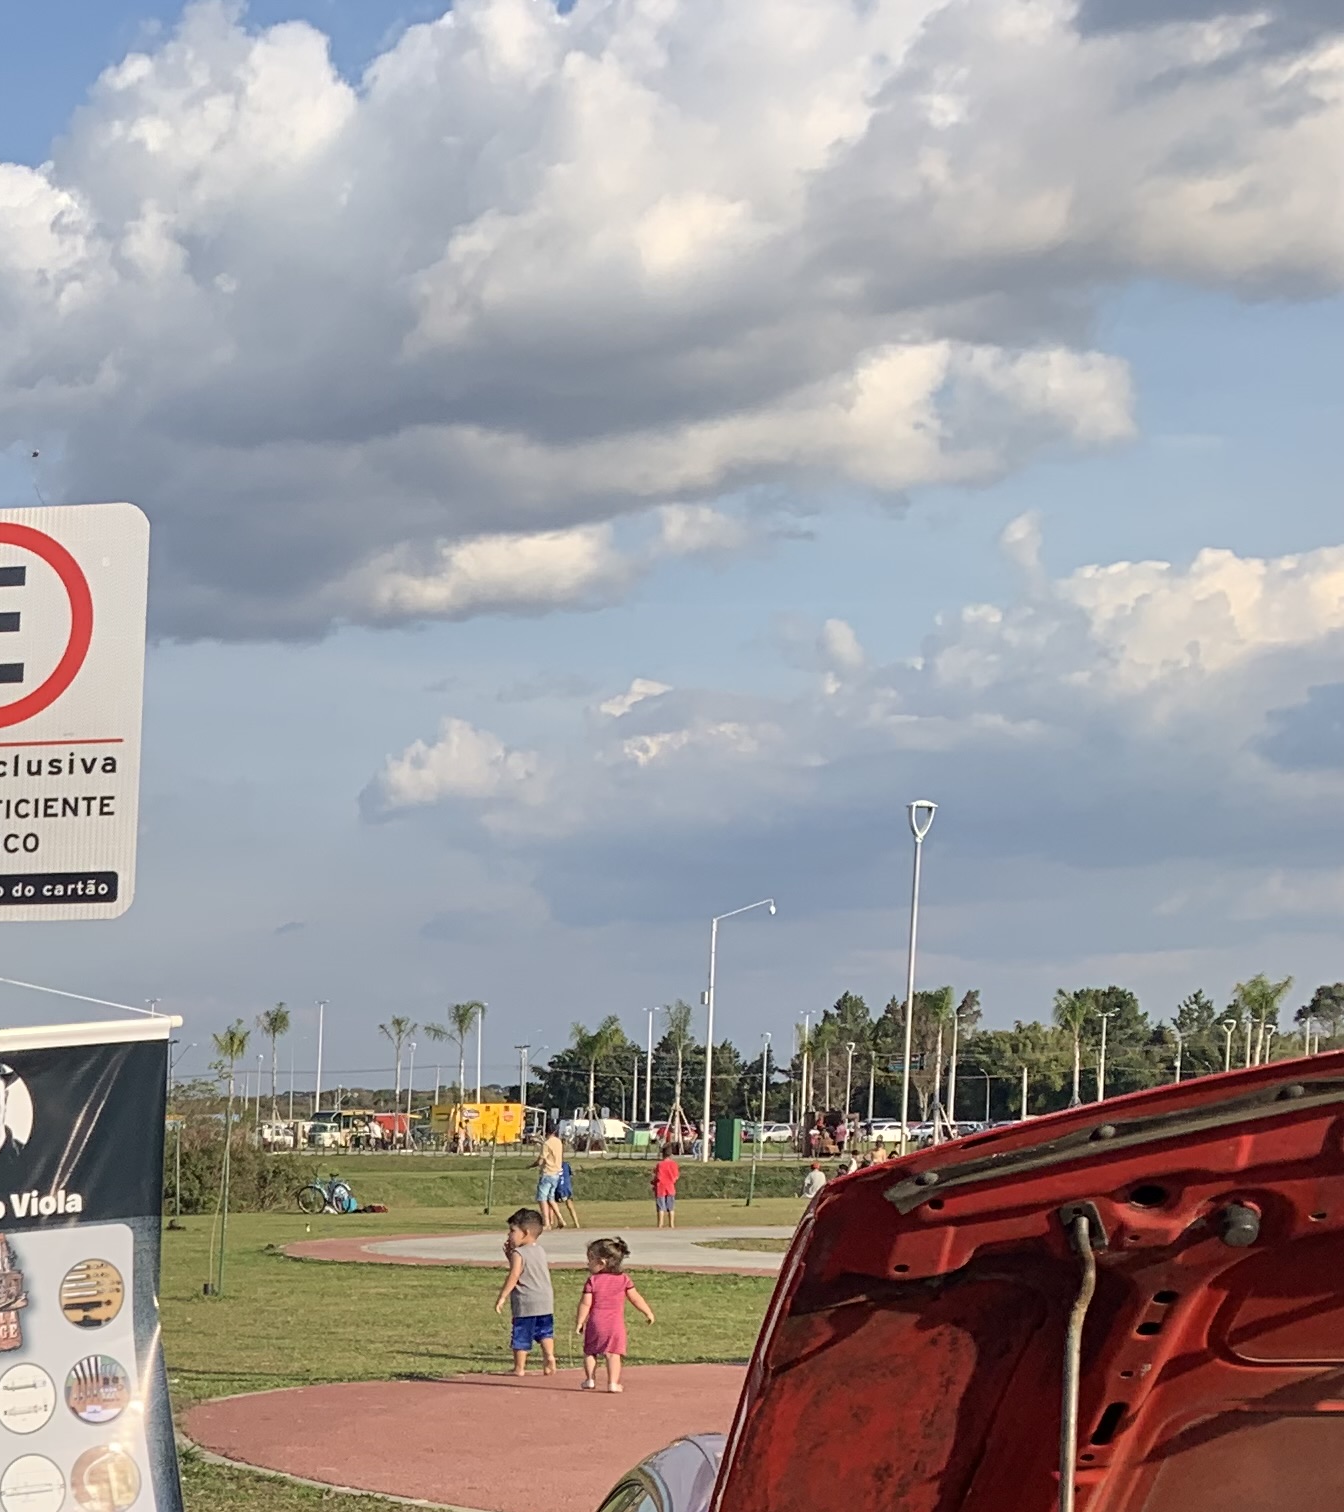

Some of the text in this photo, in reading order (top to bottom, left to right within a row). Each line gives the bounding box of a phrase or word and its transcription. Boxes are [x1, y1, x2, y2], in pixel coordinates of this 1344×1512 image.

[12, 881, 35, 898] do
[42, 879, 109, 897] cartão
[10, 1189, 83, 1218] Viola
